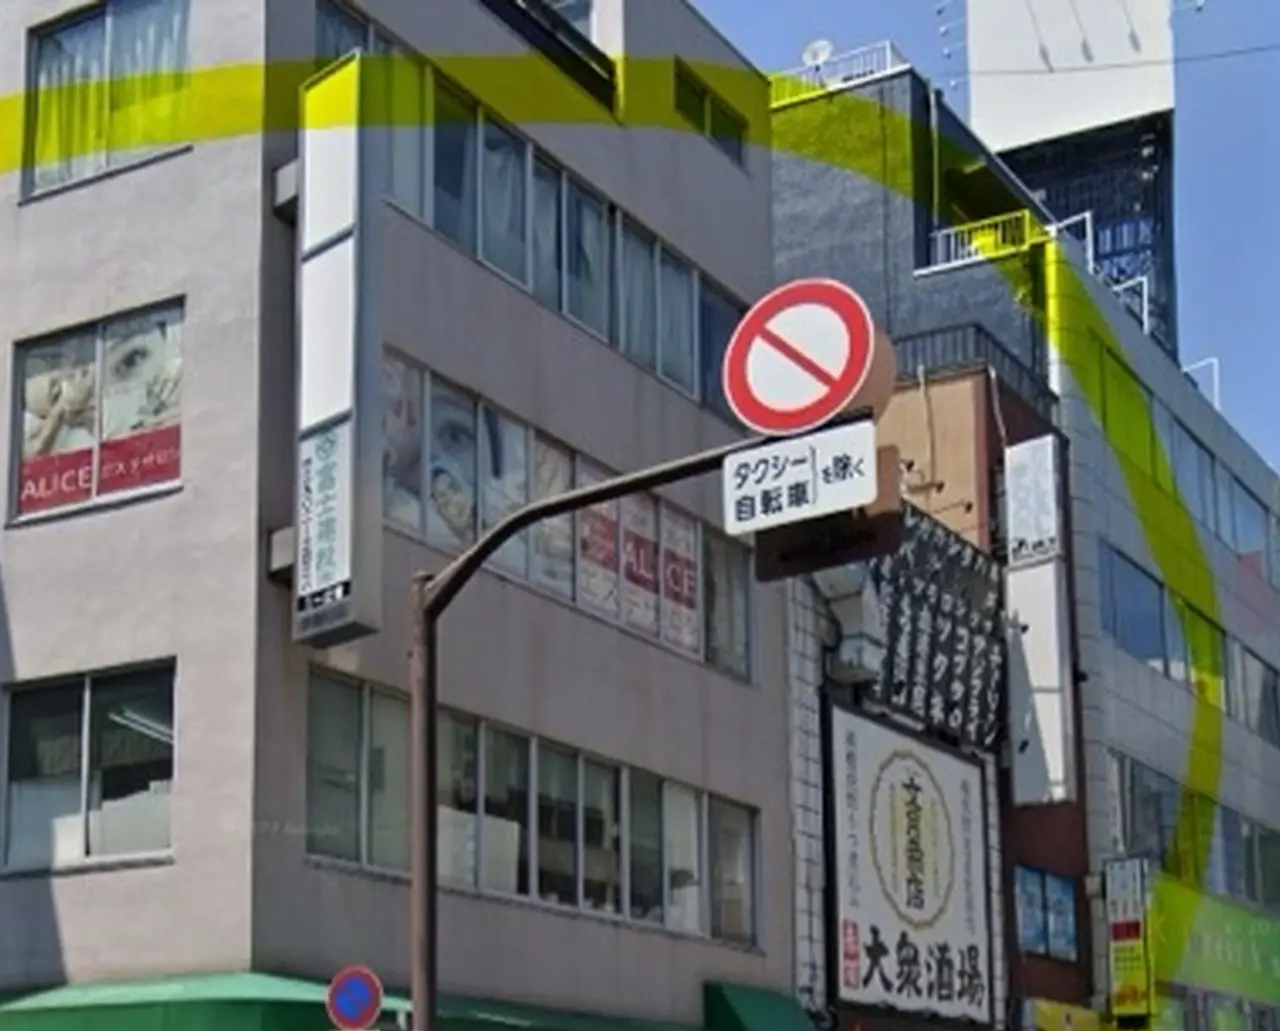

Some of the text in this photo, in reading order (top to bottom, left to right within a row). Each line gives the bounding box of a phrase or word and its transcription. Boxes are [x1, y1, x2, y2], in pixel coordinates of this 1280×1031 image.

[21, 464, 93, 500] ALICE
[734, 455, 808, 490] タクシー
[821, 453, 866, 485] を除く
[734, 480, 810, 522] 自転車
[861, 923, 986, 1009] 大衆酒場
